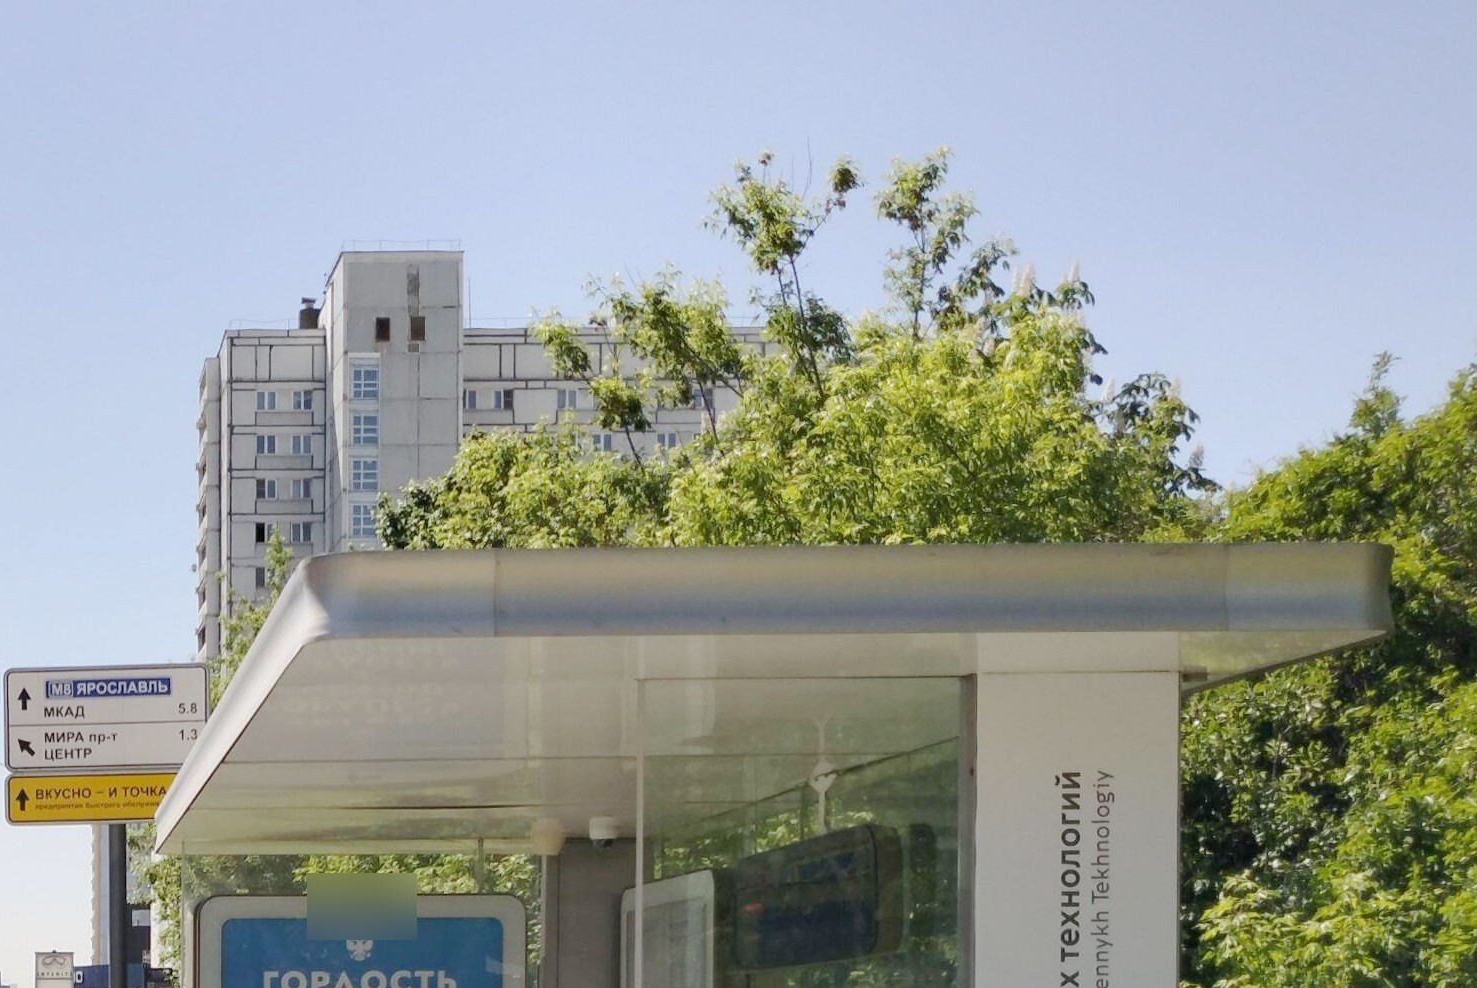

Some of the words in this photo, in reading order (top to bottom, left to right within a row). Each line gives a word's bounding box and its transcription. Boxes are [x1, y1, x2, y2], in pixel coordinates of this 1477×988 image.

[76, 679, 169, 696] ЯРОСЛАВЛЬ
[43, 706, 85, 719] МКАД
[178, 702, 198, 714] 5.8
[43, 731, 85, 743] МИРА
[88, 732, 119, 745] пр-т
[178, 728, 199, 741] 1.3
[43, 747, 93, 761] ЦЕНТР
[35, 787, 92, 800] ВКУСНО
[108, 786, 118, 798] И
[122, 785, 167, 798] ТОЧКА
[1090, 769, 1115, 904] Tekhnologiy
[1054, 771, 1082, 964] технологий
